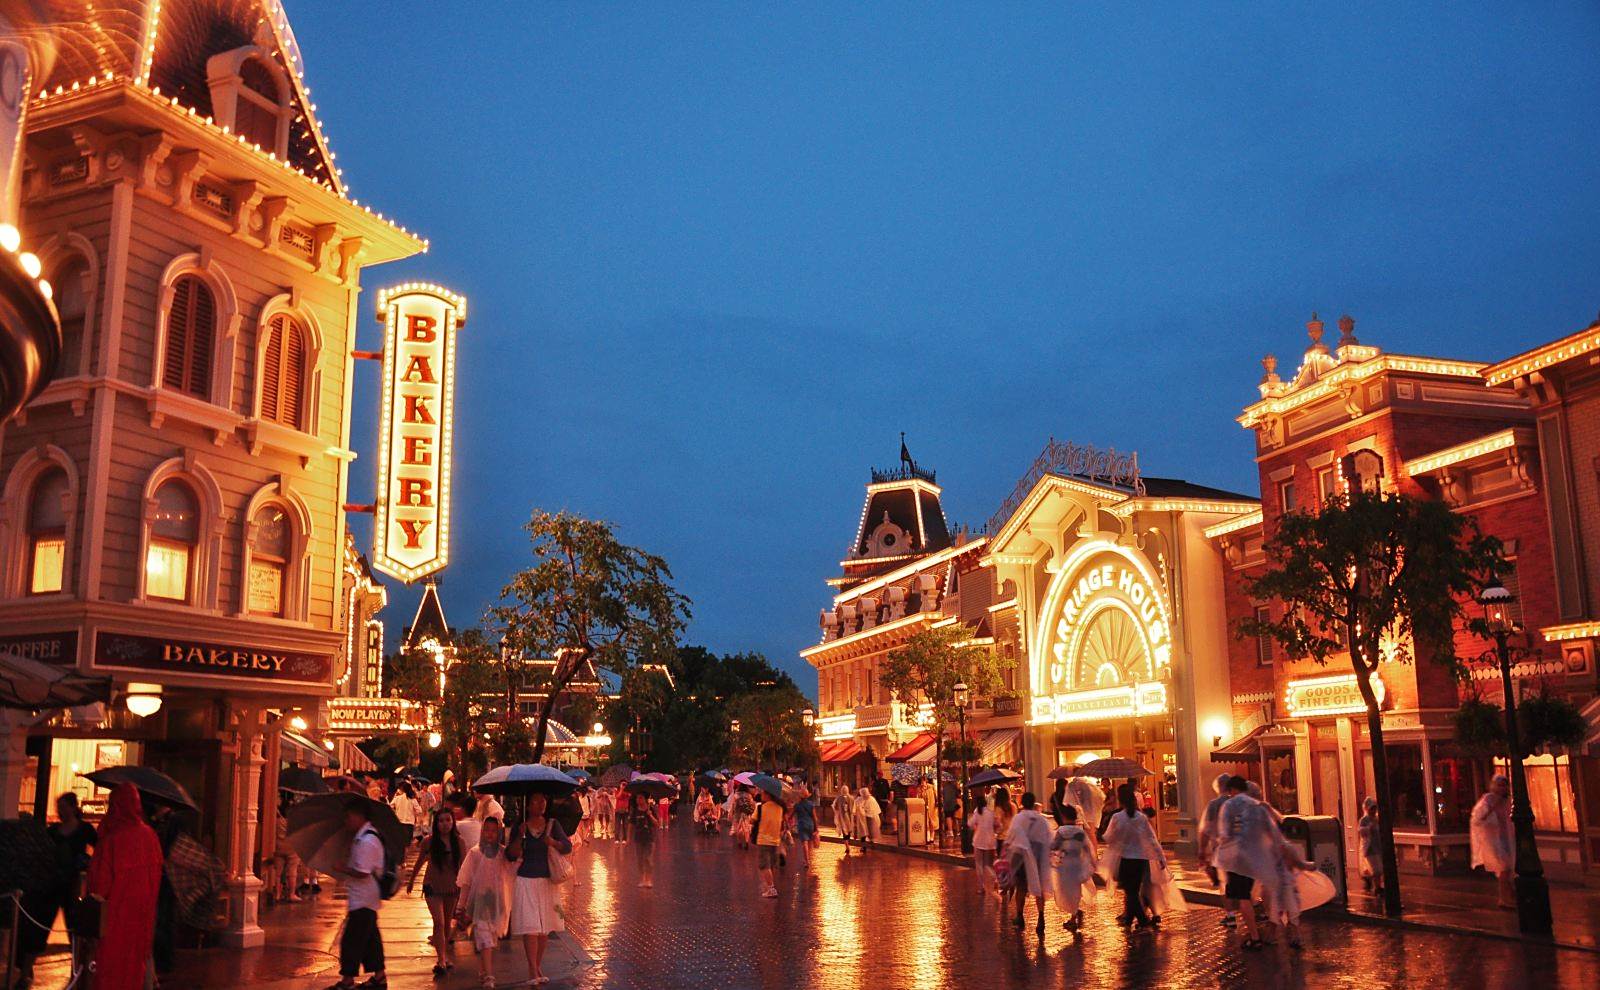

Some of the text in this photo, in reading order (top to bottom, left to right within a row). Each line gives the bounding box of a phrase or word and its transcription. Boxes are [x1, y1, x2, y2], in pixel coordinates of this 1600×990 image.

[396, 314, 438, 549] BAKERY
[1051, 565, 1171, 684] CARRIAGE HOUSE
[162, 643, 286, 671] BAKERY
[1298, 694, 1363, 708] FINE GIFT
[1305, 685, 1350, 697] GOODS
[331, 708, 396, 720] NOW PLAYI
